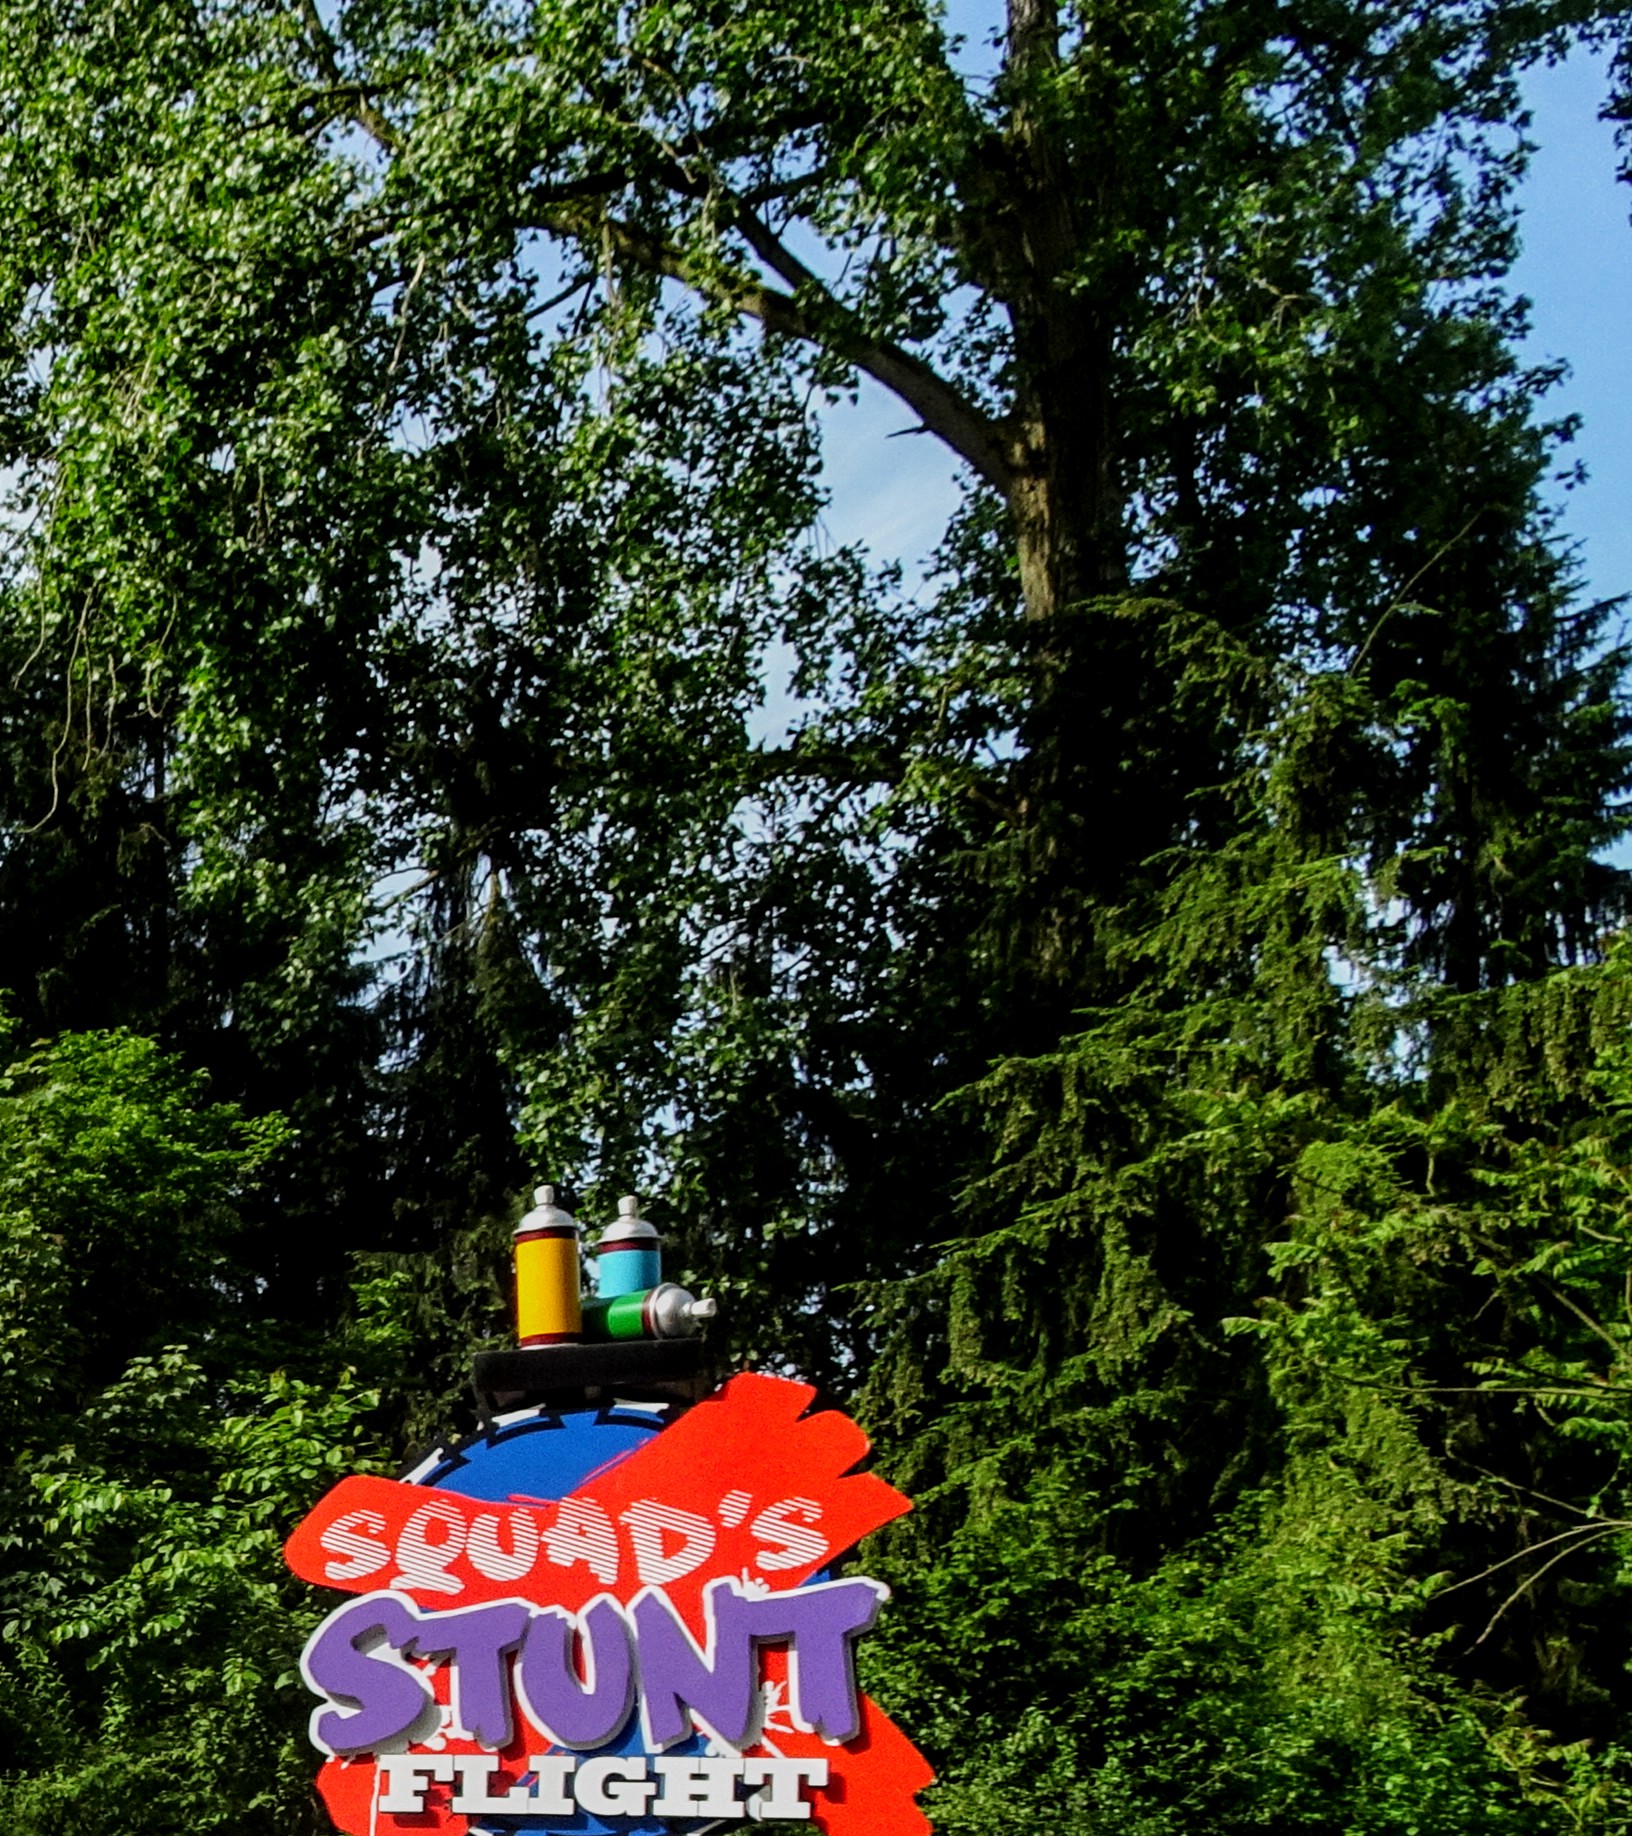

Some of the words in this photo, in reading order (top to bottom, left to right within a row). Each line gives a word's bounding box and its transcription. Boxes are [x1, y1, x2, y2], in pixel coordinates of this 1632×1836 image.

[320, 1490, 831, 1595] SQUAD'S
[300, 1576, 890, 1752] STUNT
[378, 1754, 829, 1818] FLIGHT
